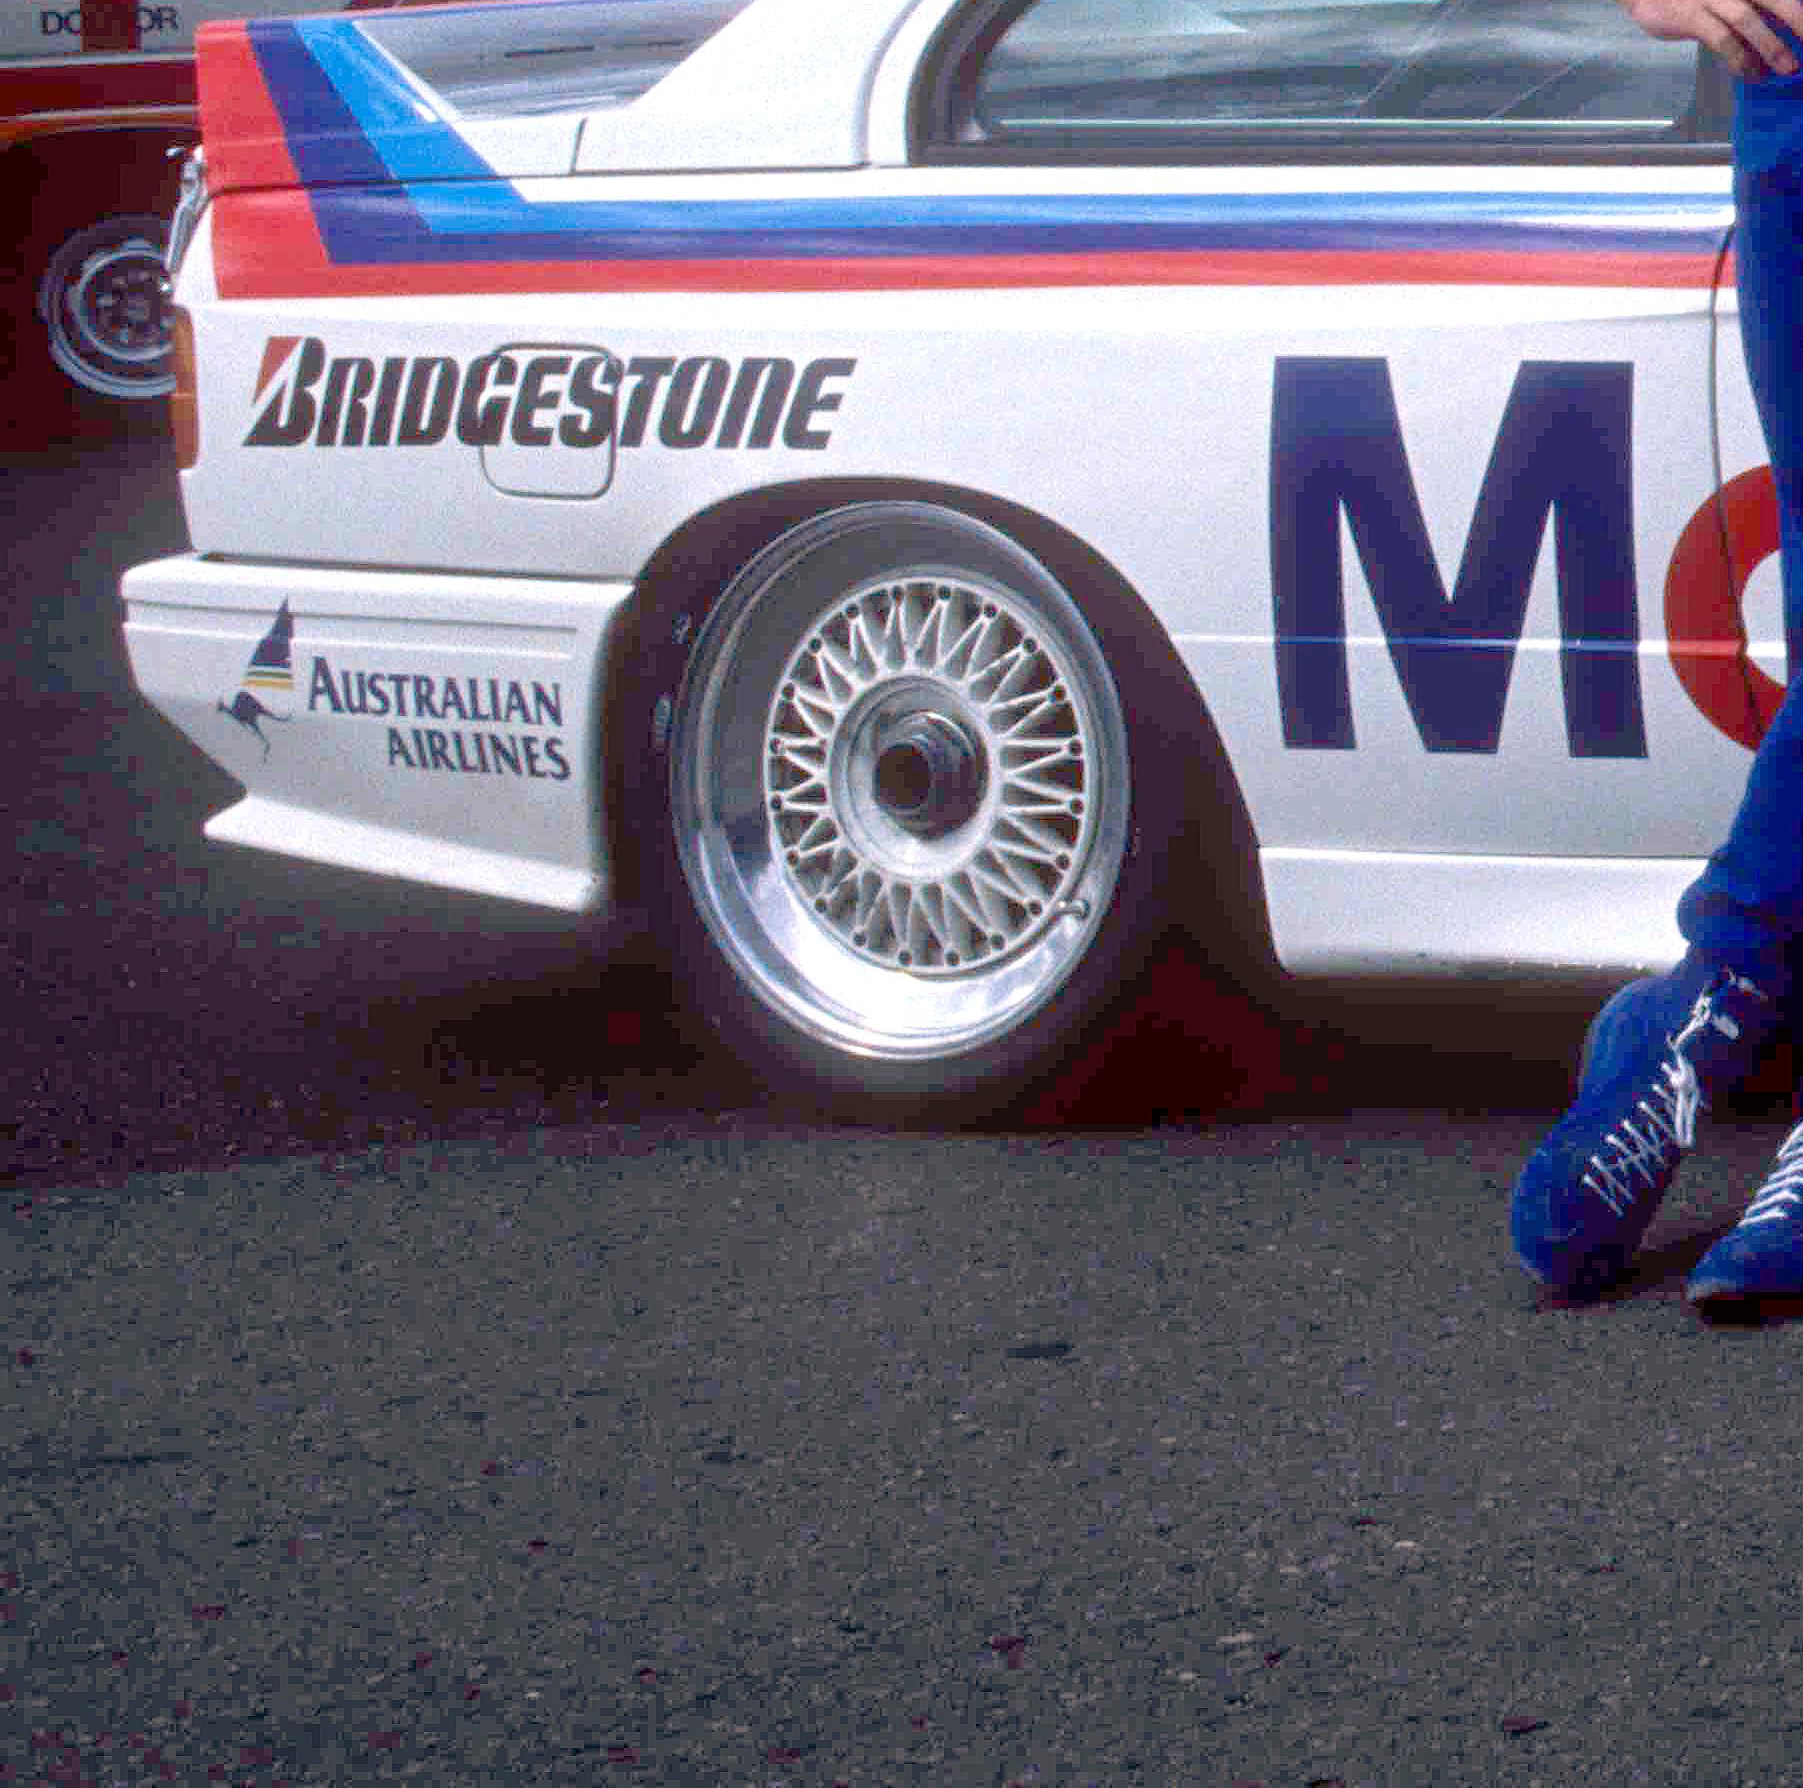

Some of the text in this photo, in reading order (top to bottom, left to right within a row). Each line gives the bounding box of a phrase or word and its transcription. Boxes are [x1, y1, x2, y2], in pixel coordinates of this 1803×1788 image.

[41, 4, 179, 36] DOOR
[243, 335, 858, 451] BRIDGESTONE
[308, 655, 565, 728] AUSTRALIAN
[387, 727, 572, 781] AIRLINES
